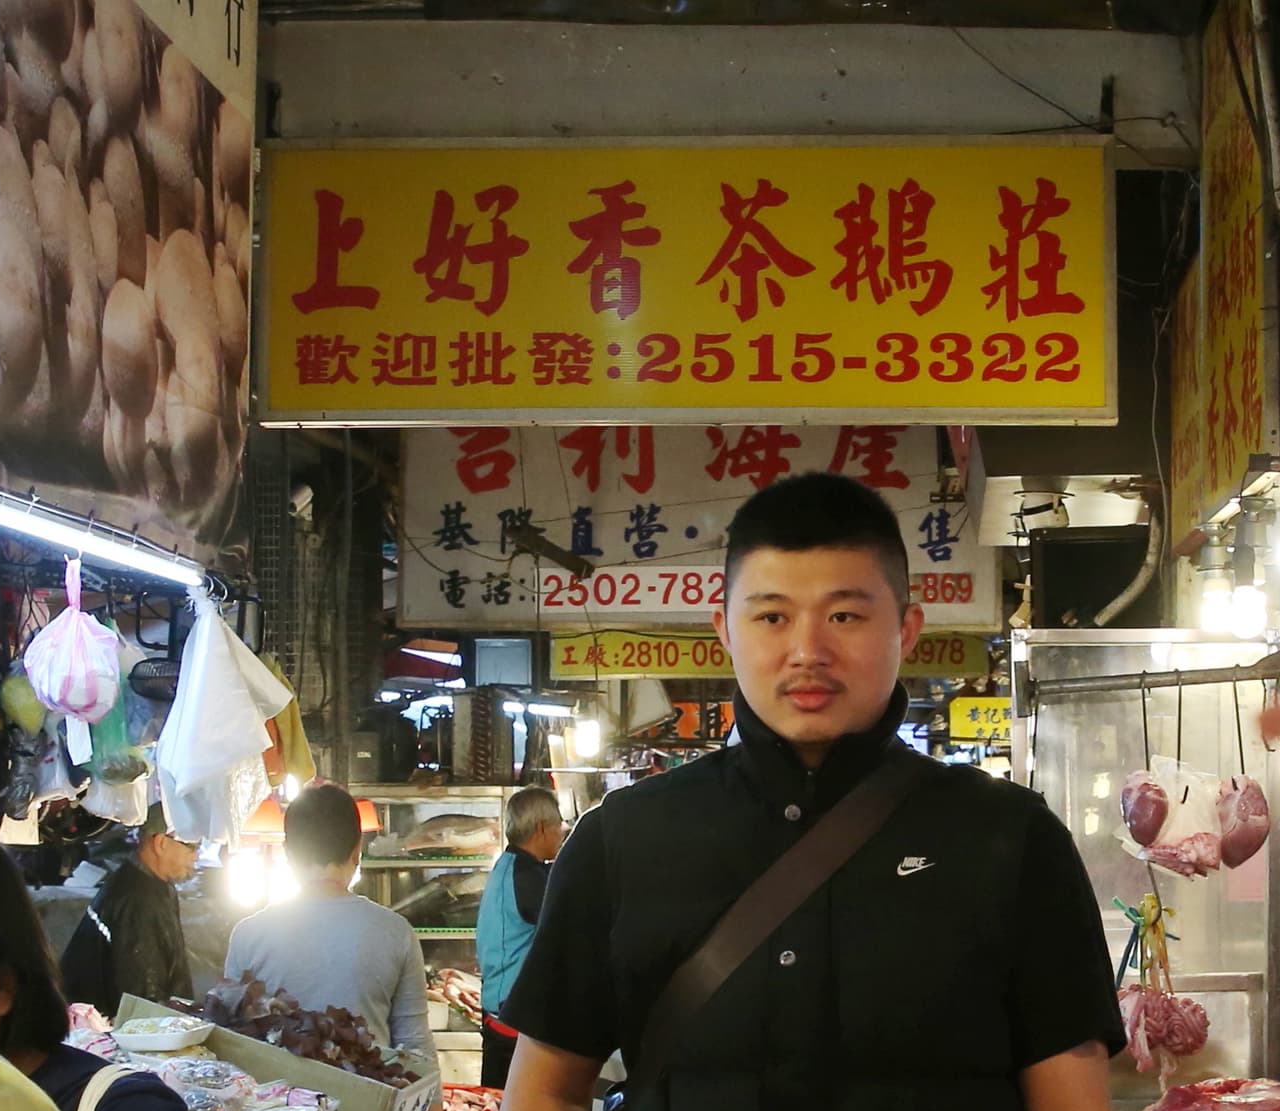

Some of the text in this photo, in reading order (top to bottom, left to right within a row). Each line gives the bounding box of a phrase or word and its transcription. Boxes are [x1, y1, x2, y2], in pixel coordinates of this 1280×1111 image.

[291, 177, 1086, 321] 上好香茶鵝莊
[295, 331, 1081, 387] 歡迎批發:2515-3322
[918, 510, 961, 563] 售
[561, 640, 733, 667] 工廠:2810-06
